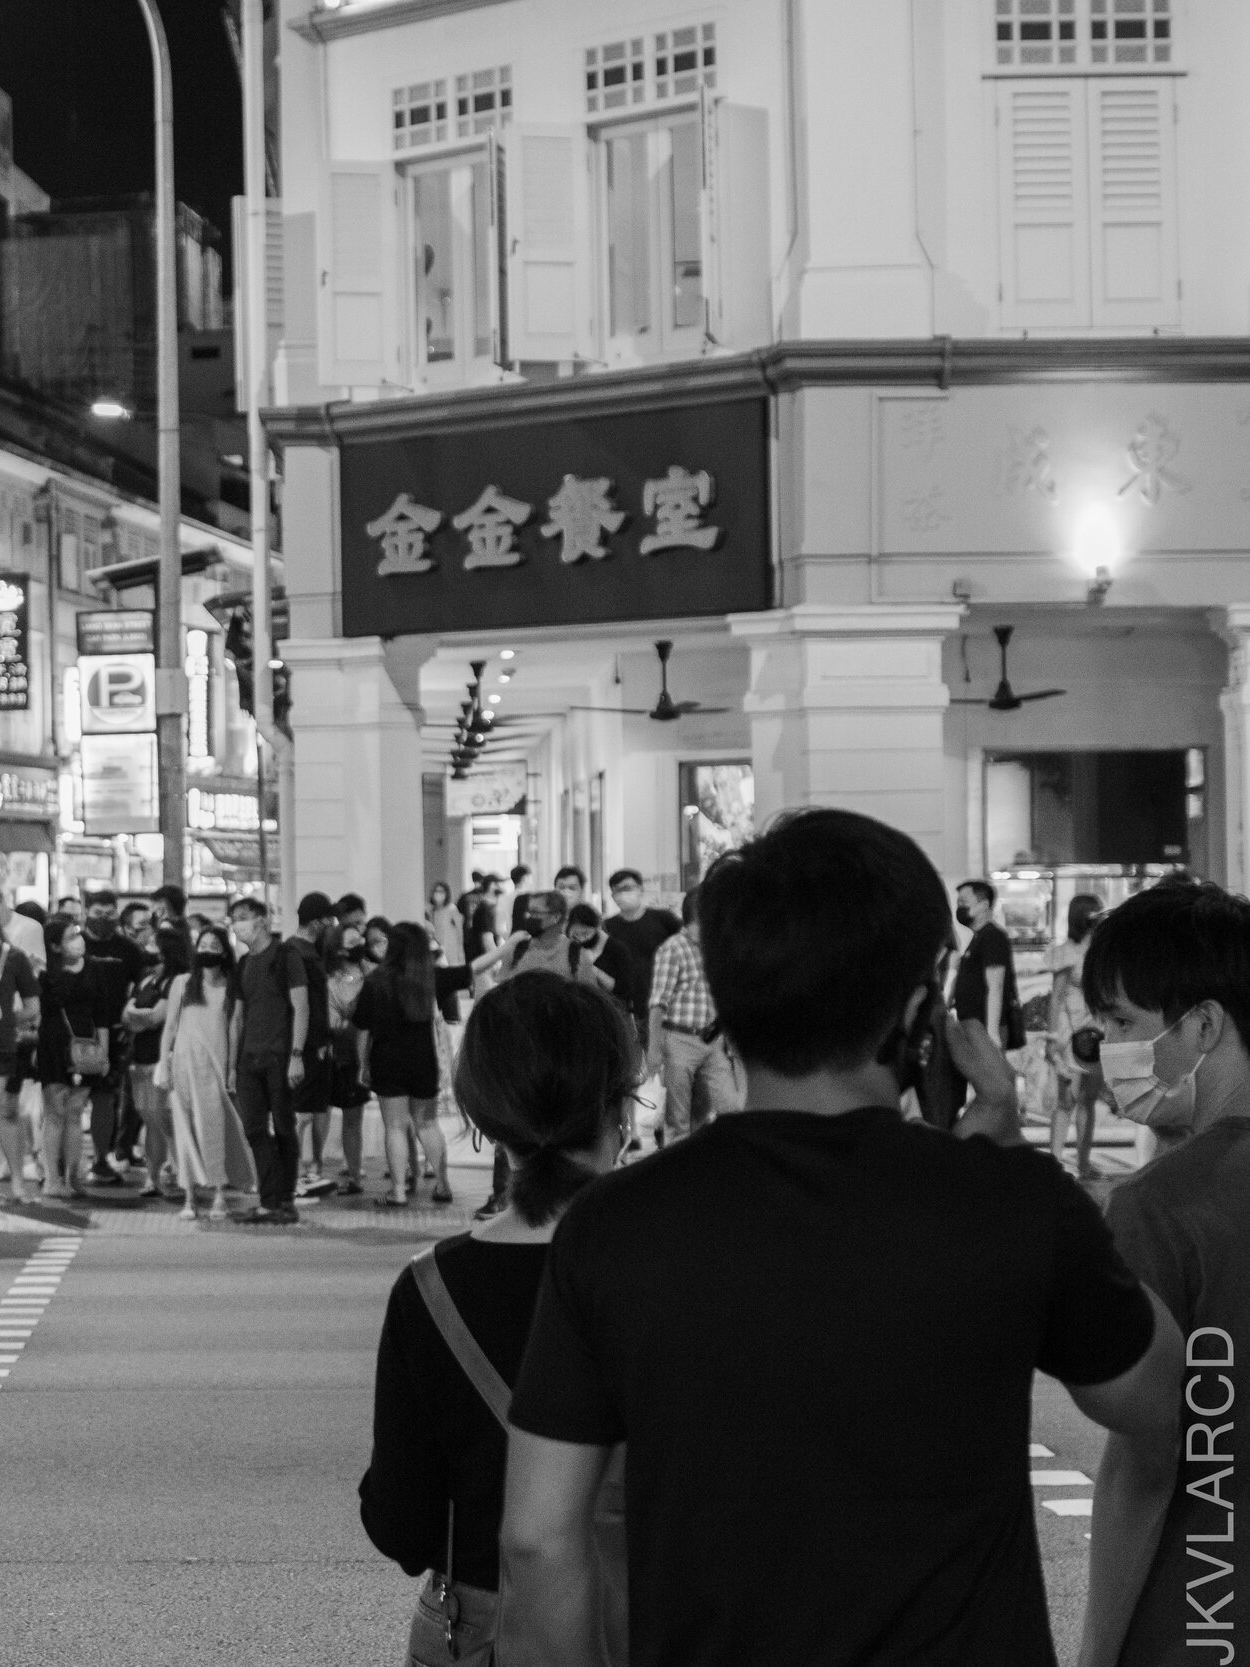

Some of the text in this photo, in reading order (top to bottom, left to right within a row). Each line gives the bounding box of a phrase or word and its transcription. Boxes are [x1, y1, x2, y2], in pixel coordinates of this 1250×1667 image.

[366, 465, 722, 576] 金金餐室
[99, 663, 143, 708] P
